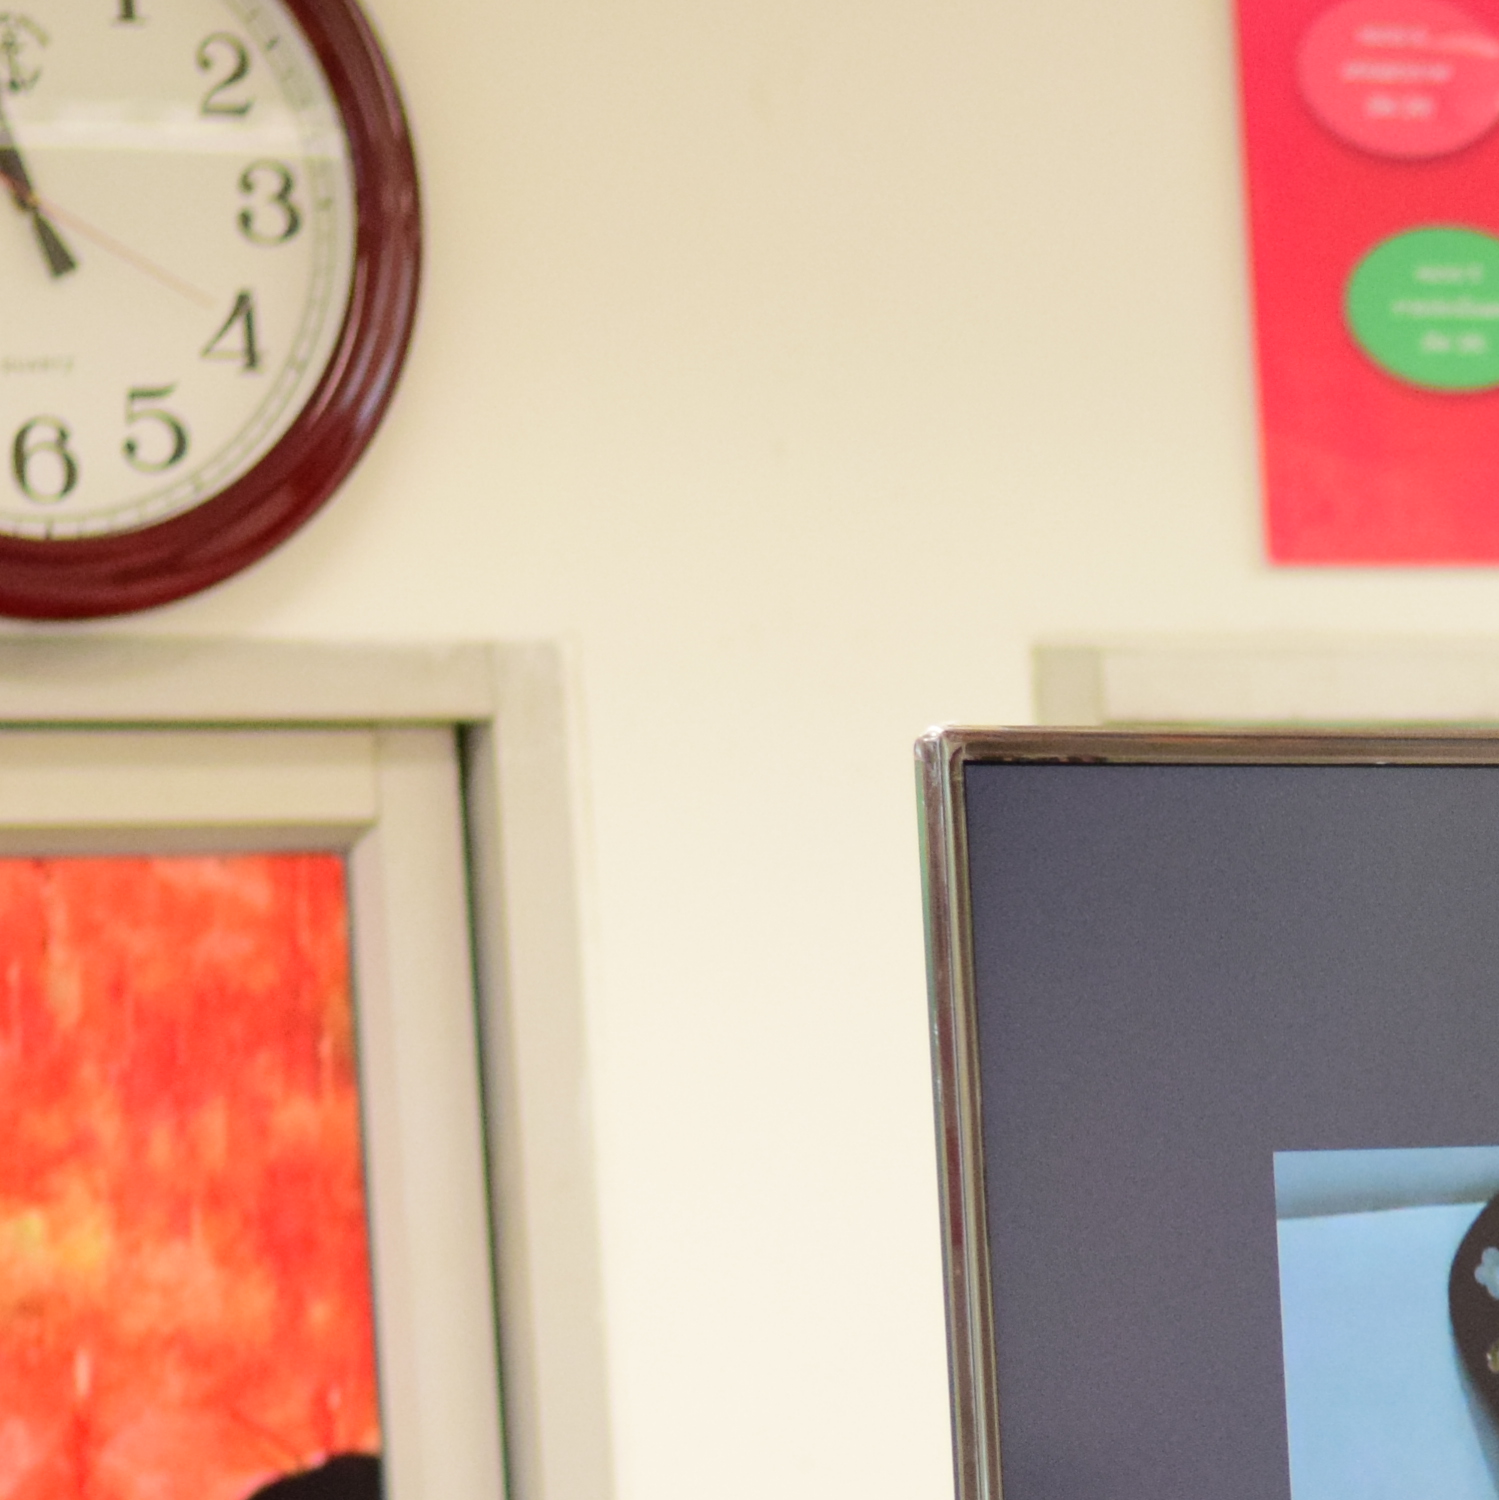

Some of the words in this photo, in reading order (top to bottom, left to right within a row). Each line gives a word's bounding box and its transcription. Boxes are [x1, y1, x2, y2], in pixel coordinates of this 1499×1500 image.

[195, 31, 253, 117] 2
[237, 159, 302, 247] 3
[200, 290, 264, 373] 4
[11, 415, 79, 503] 6
[122, 384, 190, 473] 5
